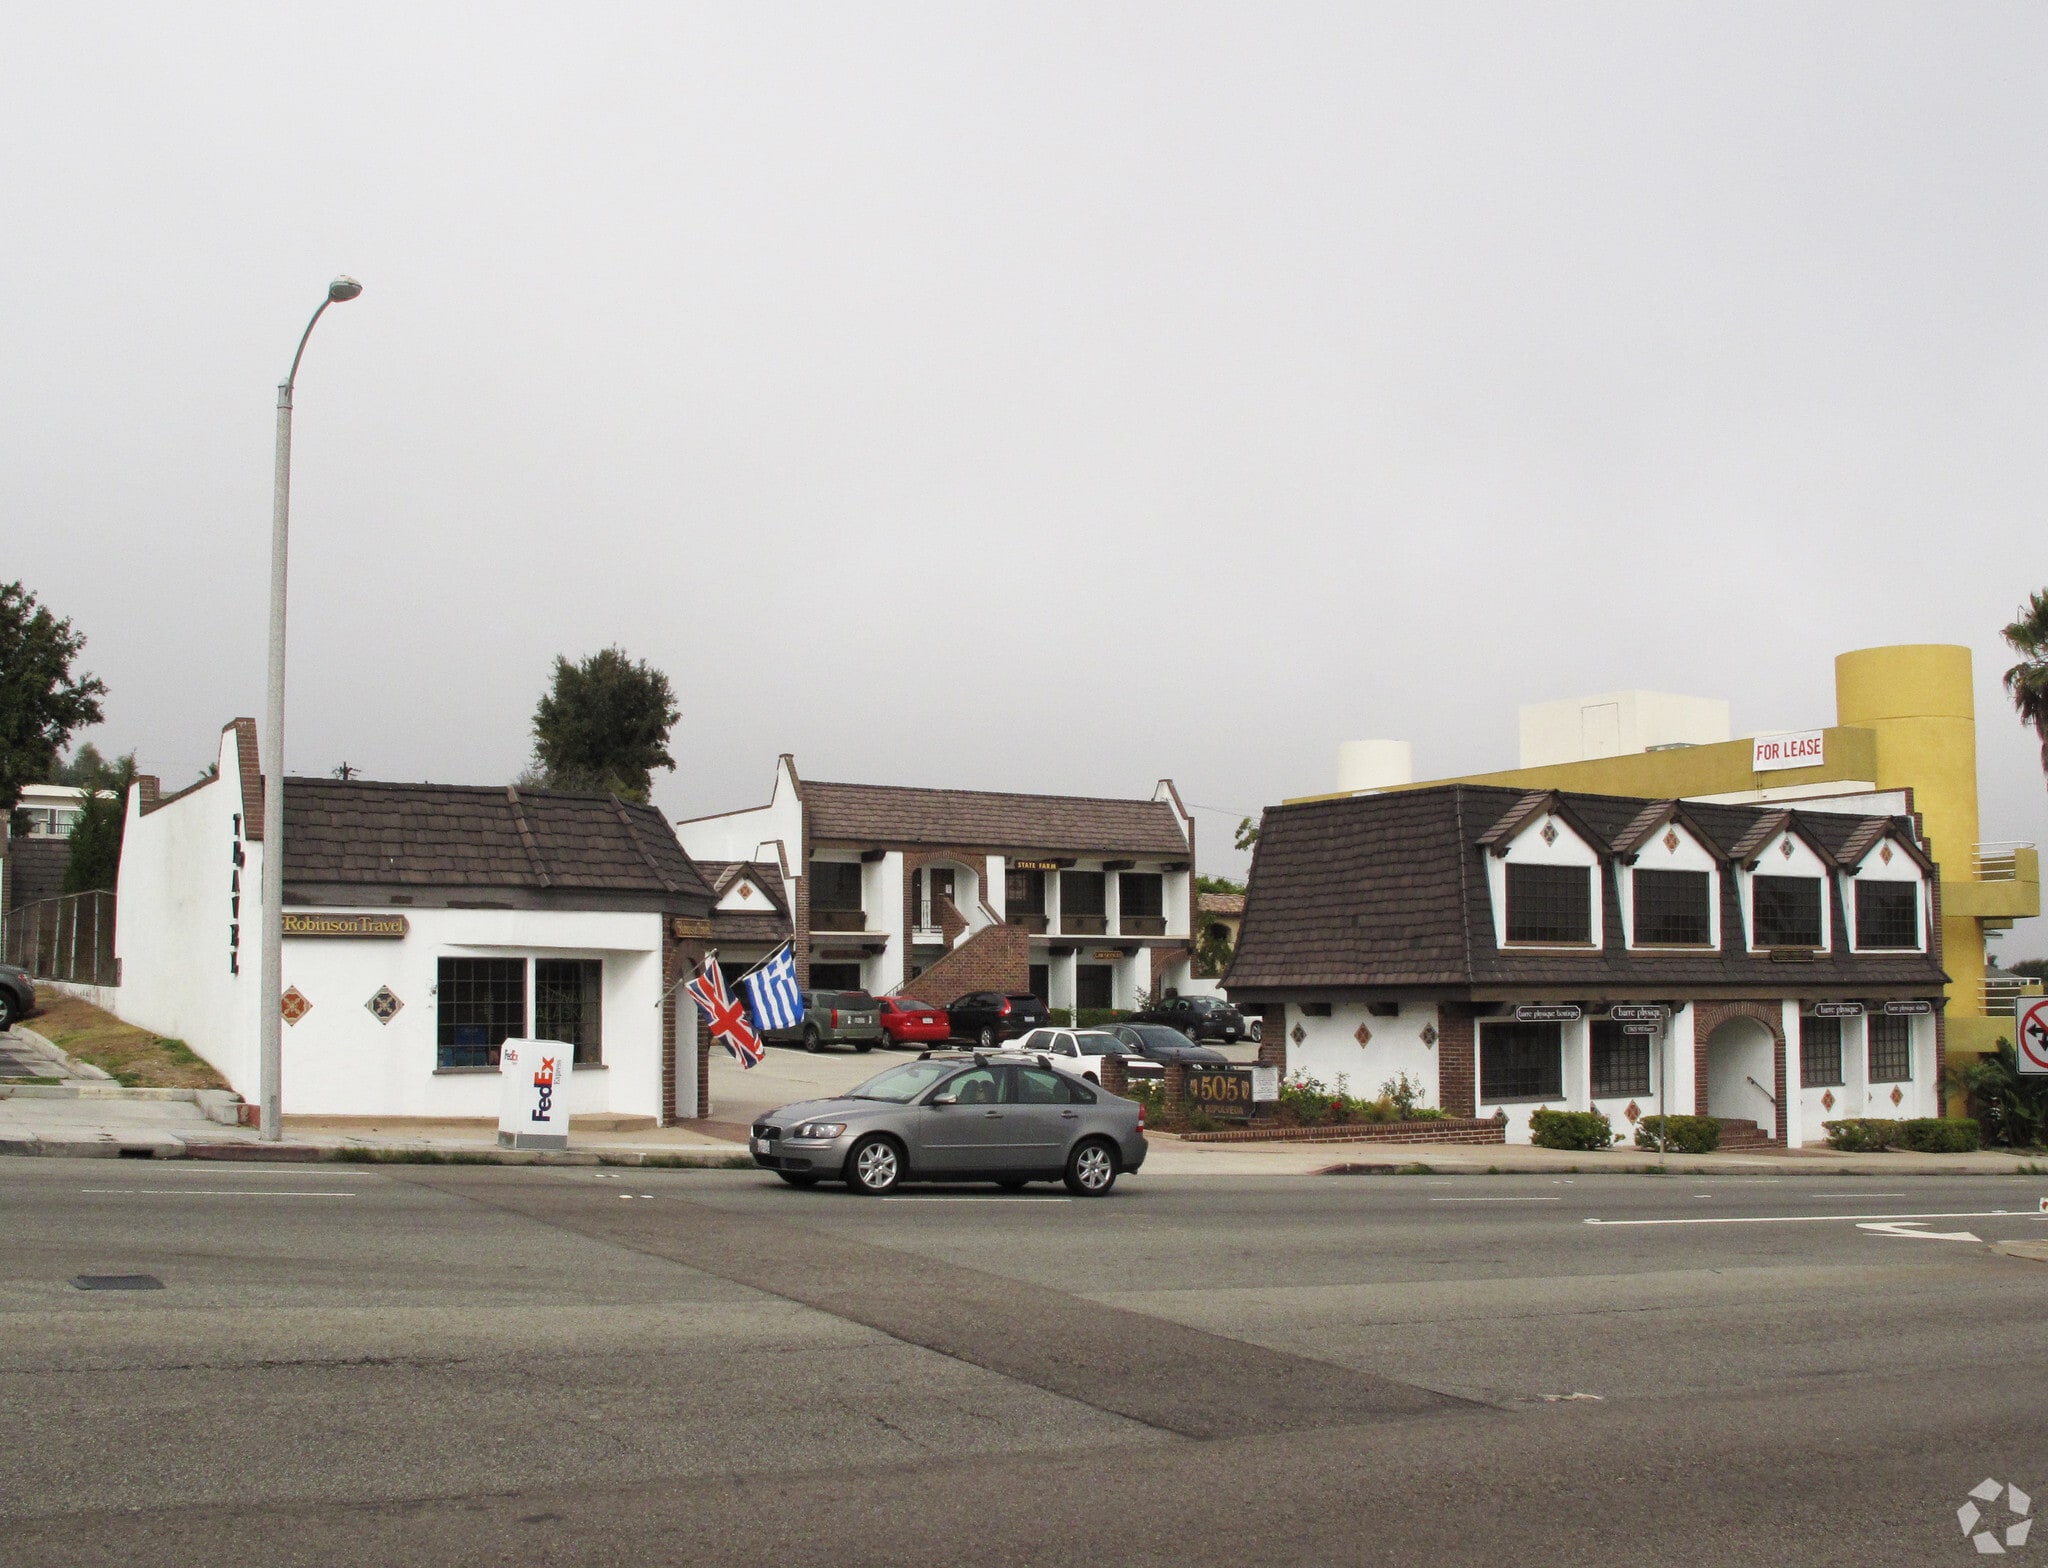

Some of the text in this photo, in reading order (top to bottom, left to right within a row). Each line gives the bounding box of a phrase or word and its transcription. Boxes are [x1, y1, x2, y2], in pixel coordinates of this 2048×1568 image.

[1757, 738, 1821, 761] FOR LEASE
[1017, 861, 1057, 870] STATE FARM
[230, 813, 245, 976] TRAVEL
[283, 915, 403, 932] Robinson Travel
[1618, 1007, 1660, 1019] barre physiqu
[504, 1049, 519, 1062] FedEx
[532, 1056, 555, 1122] FedEx
[1201, 1075, 1239, 1101] 505
